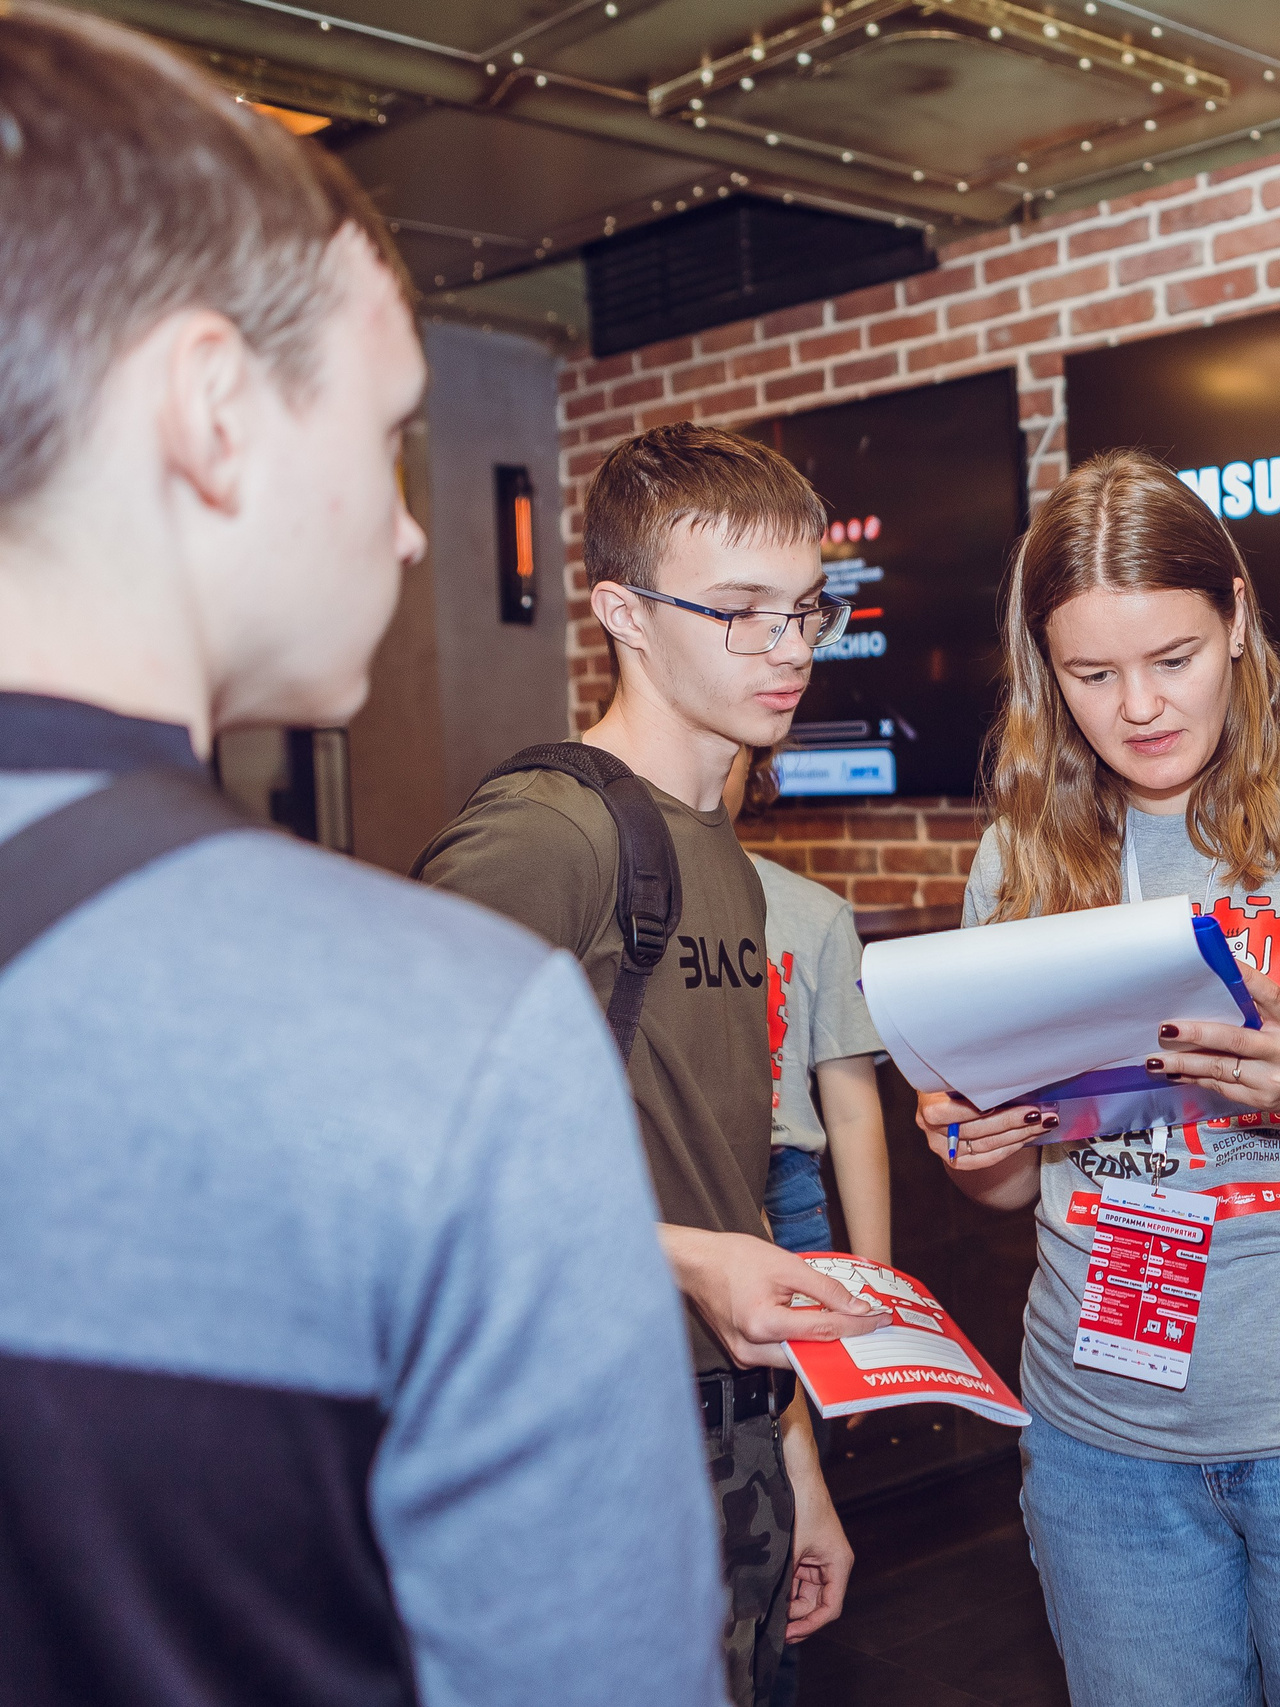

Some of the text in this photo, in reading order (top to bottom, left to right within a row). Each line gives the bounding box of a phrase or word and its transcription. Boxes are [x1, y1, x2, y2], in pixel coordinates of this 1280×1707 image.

[1215, 1151, 1280, 1168] КОНТРОЛЬНАЯ
[1105, 1213, 1146, 1229] ПРОГРАММА
[1147, 1222, 1198, 1239] МЕРОПРИЯТИЯ
[863, 1369, 995, 1396] ИНФОРМАТИКА
